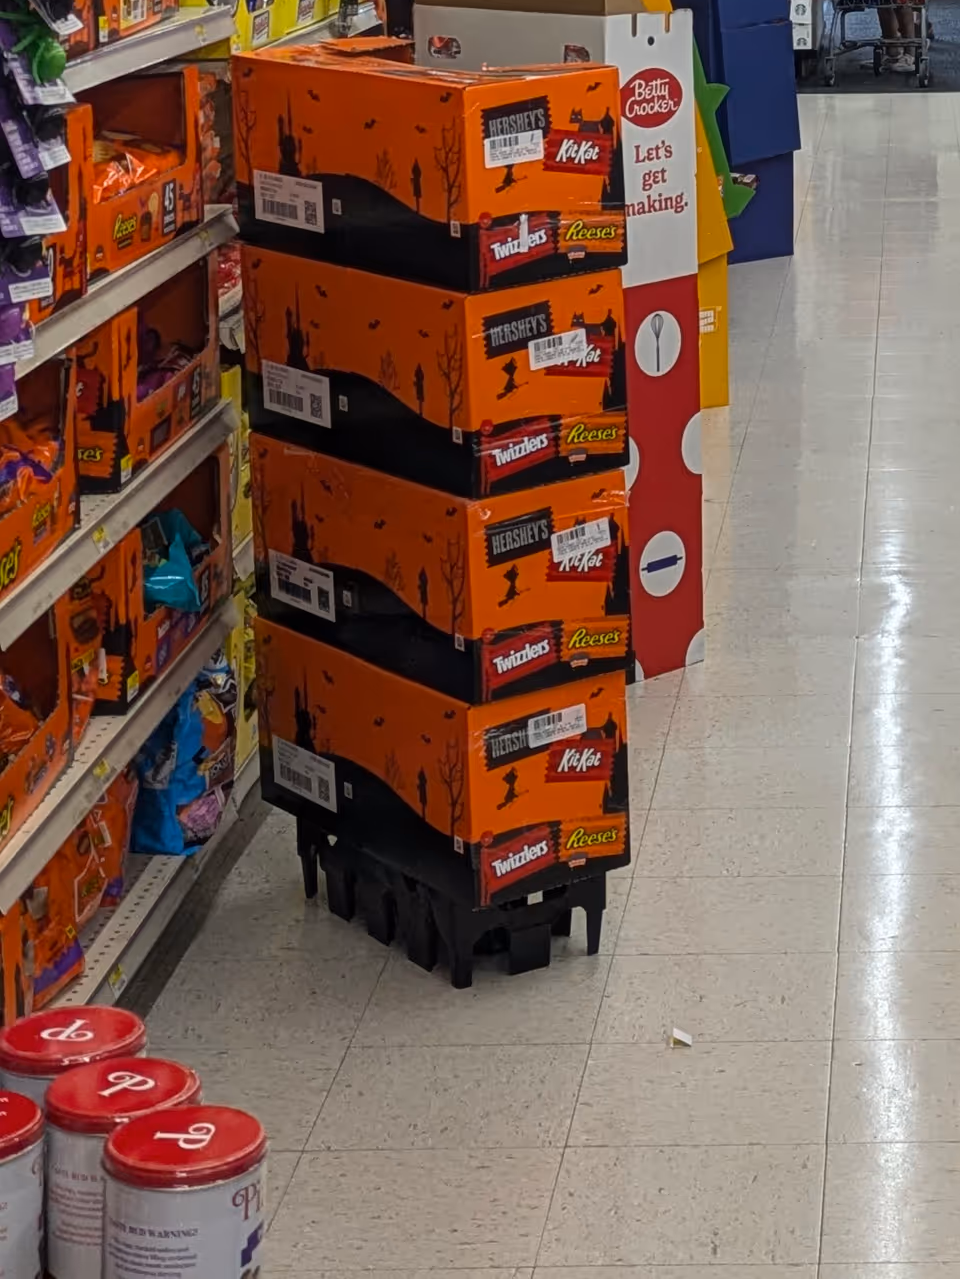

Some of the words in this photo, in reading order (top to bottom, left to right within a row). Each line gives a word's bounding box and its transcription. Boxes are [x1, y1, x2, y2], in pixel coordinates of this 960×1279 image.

[632, 78, 669, 102] Betty
[625, 93, 678, 116] Crocker
[489, 108, 546, 136] HERSHEY'S
[634, 140, 673, 164] Let's
[641, 166, 668, 191] get
[565, 220, 617, 242] Reese's
[490, 316, 547, 348] HERSHEY'S
[566, 424, 618, 444] Reese's
[491, 432, 549, 467] Twizzlers
[491, 523, 550, 556] HERSHEY'S
[567, 628, 622, 649] Reese's
[492, 639, 551, 675] Twizzlers
[566, 828, 618, 848] Reese's
[491, 840, 549, 878] Twizzlers
